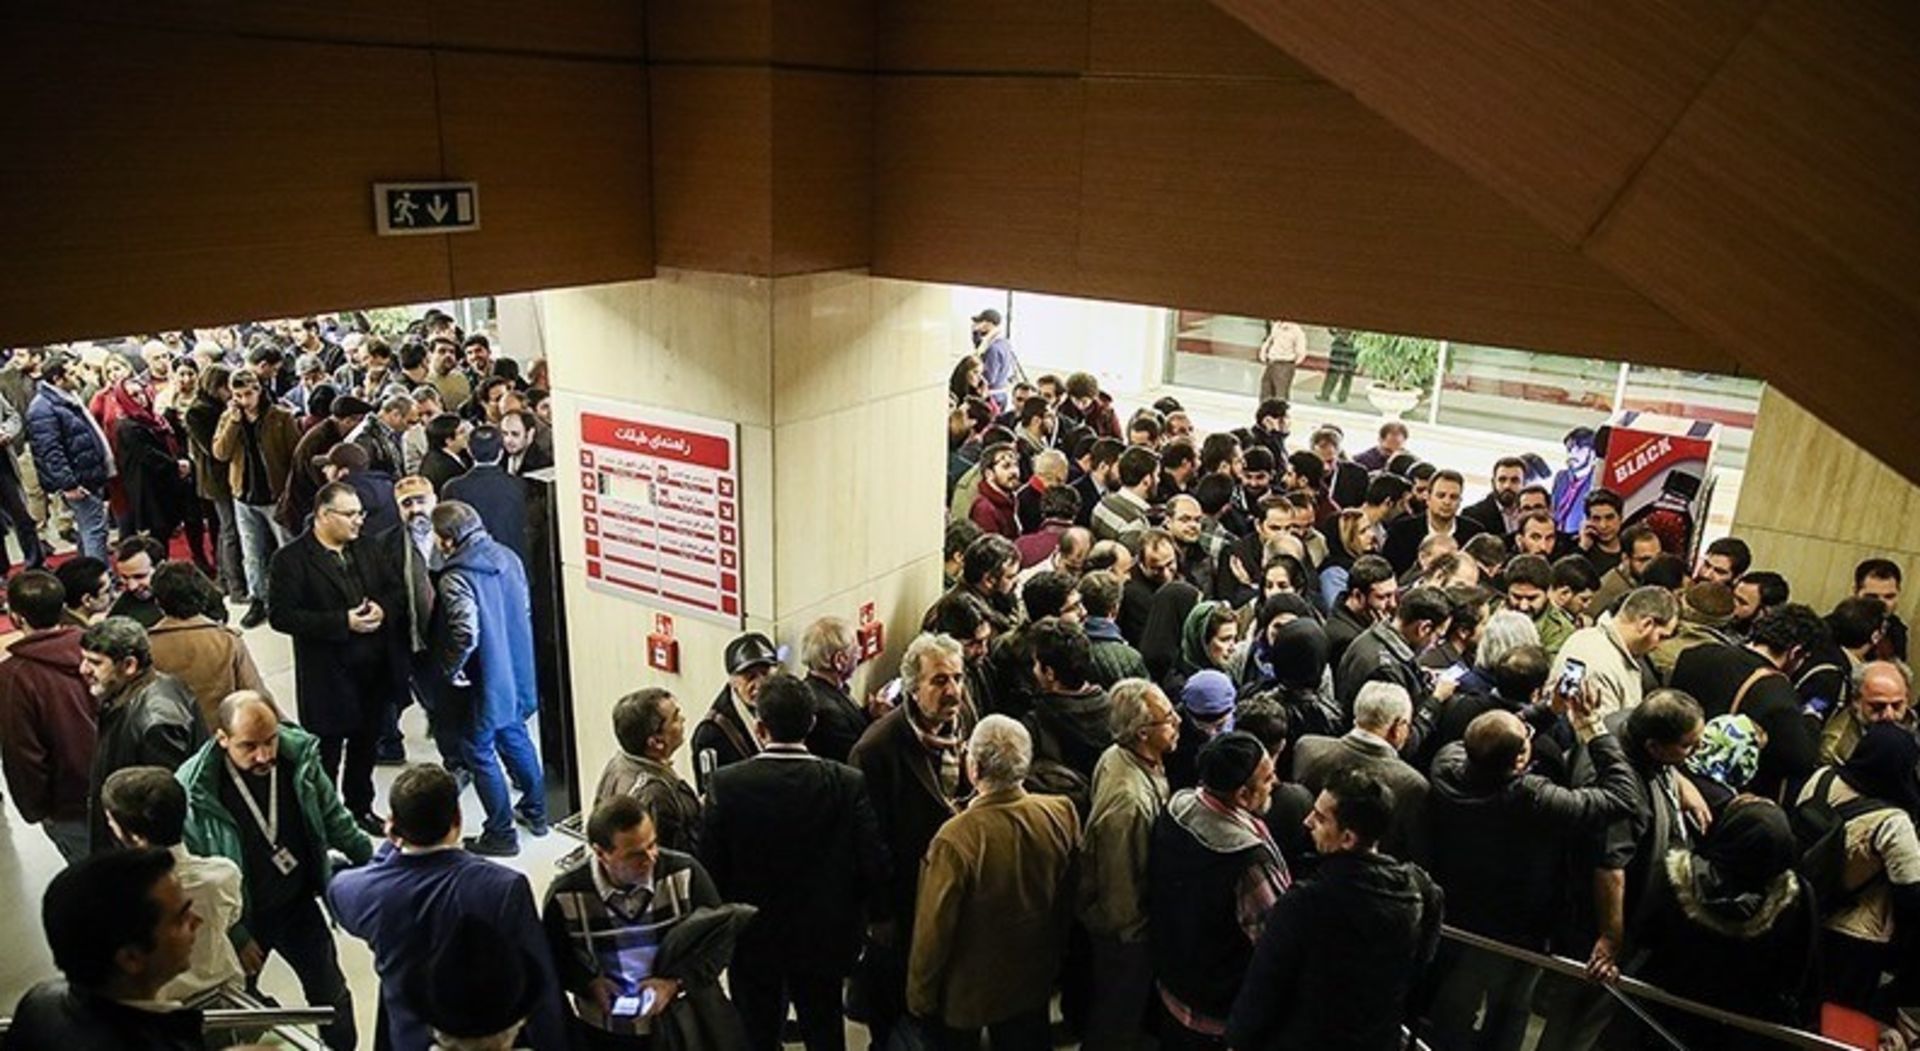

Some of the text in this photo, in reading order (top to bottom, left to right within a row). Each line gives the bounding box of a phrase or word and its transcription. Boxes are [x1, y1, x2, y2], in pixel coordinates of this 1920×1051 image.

[614, 427, 691, 456] راهنمای طبقات
[1615, 436, 1672, 483] BLACK
